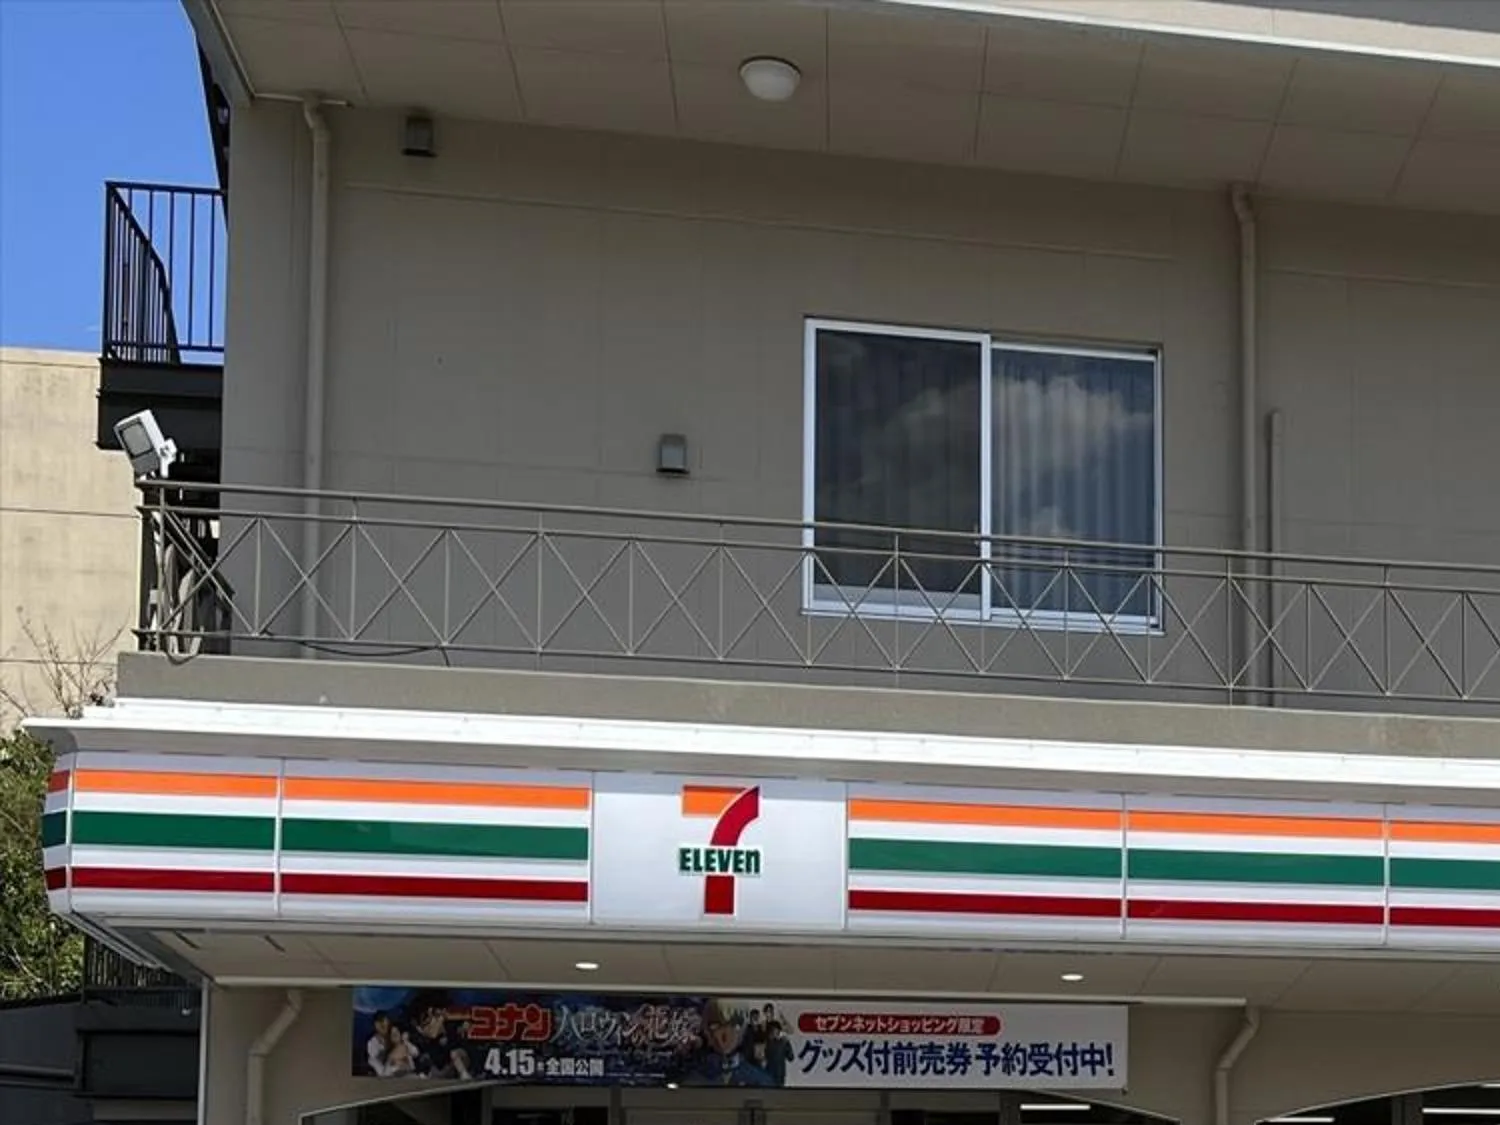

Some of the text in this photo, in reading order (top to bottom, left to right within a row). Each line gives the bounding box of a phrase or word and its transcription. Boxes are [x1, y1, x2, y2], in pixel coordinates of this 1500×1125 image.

[682, 785, 760, 915] 7
[467, 1002, 552, 1042] コナン
[814, 1015, 985, 1034] セブンネットショッピング限定
[483, 1047, 605, 1077] 4.15 全国公開
